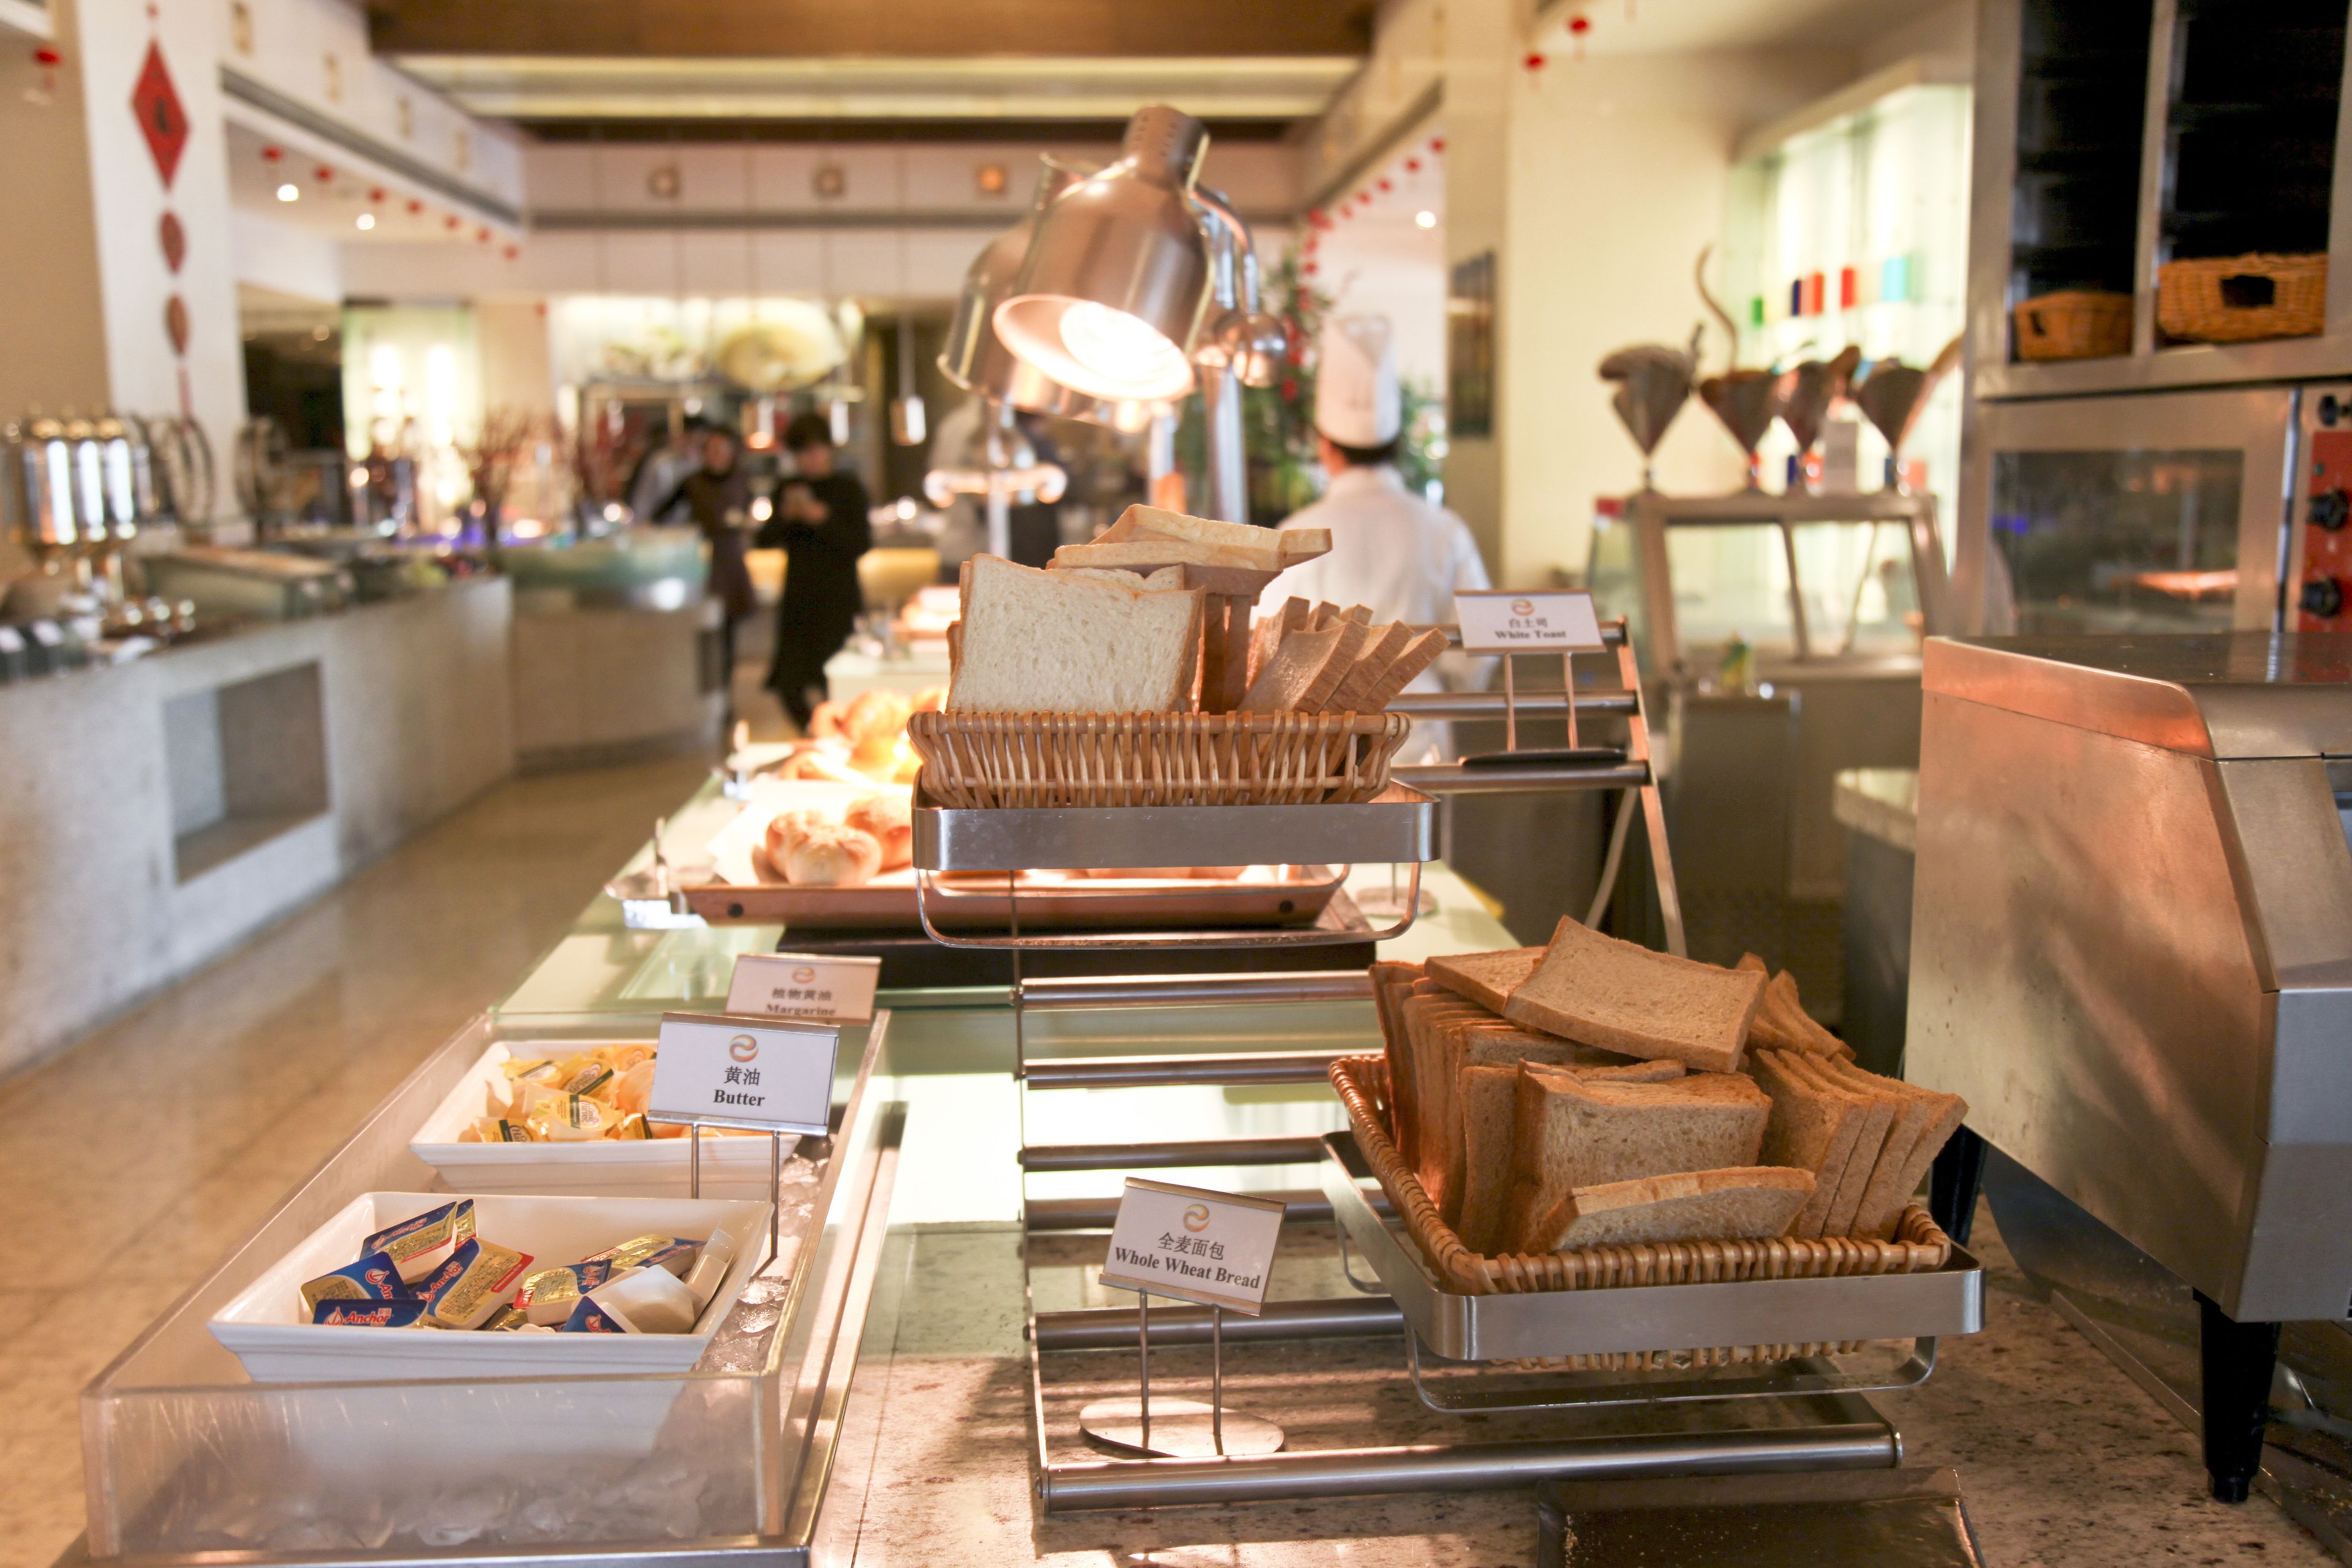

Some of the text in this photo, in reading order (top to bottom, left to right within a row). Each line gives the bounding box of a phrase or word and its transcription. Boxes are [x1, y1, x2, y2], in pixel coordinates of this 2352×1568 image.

[1494, 630, 1566, 638] White Toast
[772, 988, 832, 1001] 植物黄油
[765, 1004, 835, 1016] Margarine
[723, 1066, 760, 1086] 黄油
[713, 1089, 766, 1107] Butter
[1158, 1232, 1224, 1261] 全麦面包
[1115, 1247, 1261, 1289] Whole Wheat Bread
[431, 1264, 461, 1293] Anchor
[345, 1311, 390, 1324] Anchor
